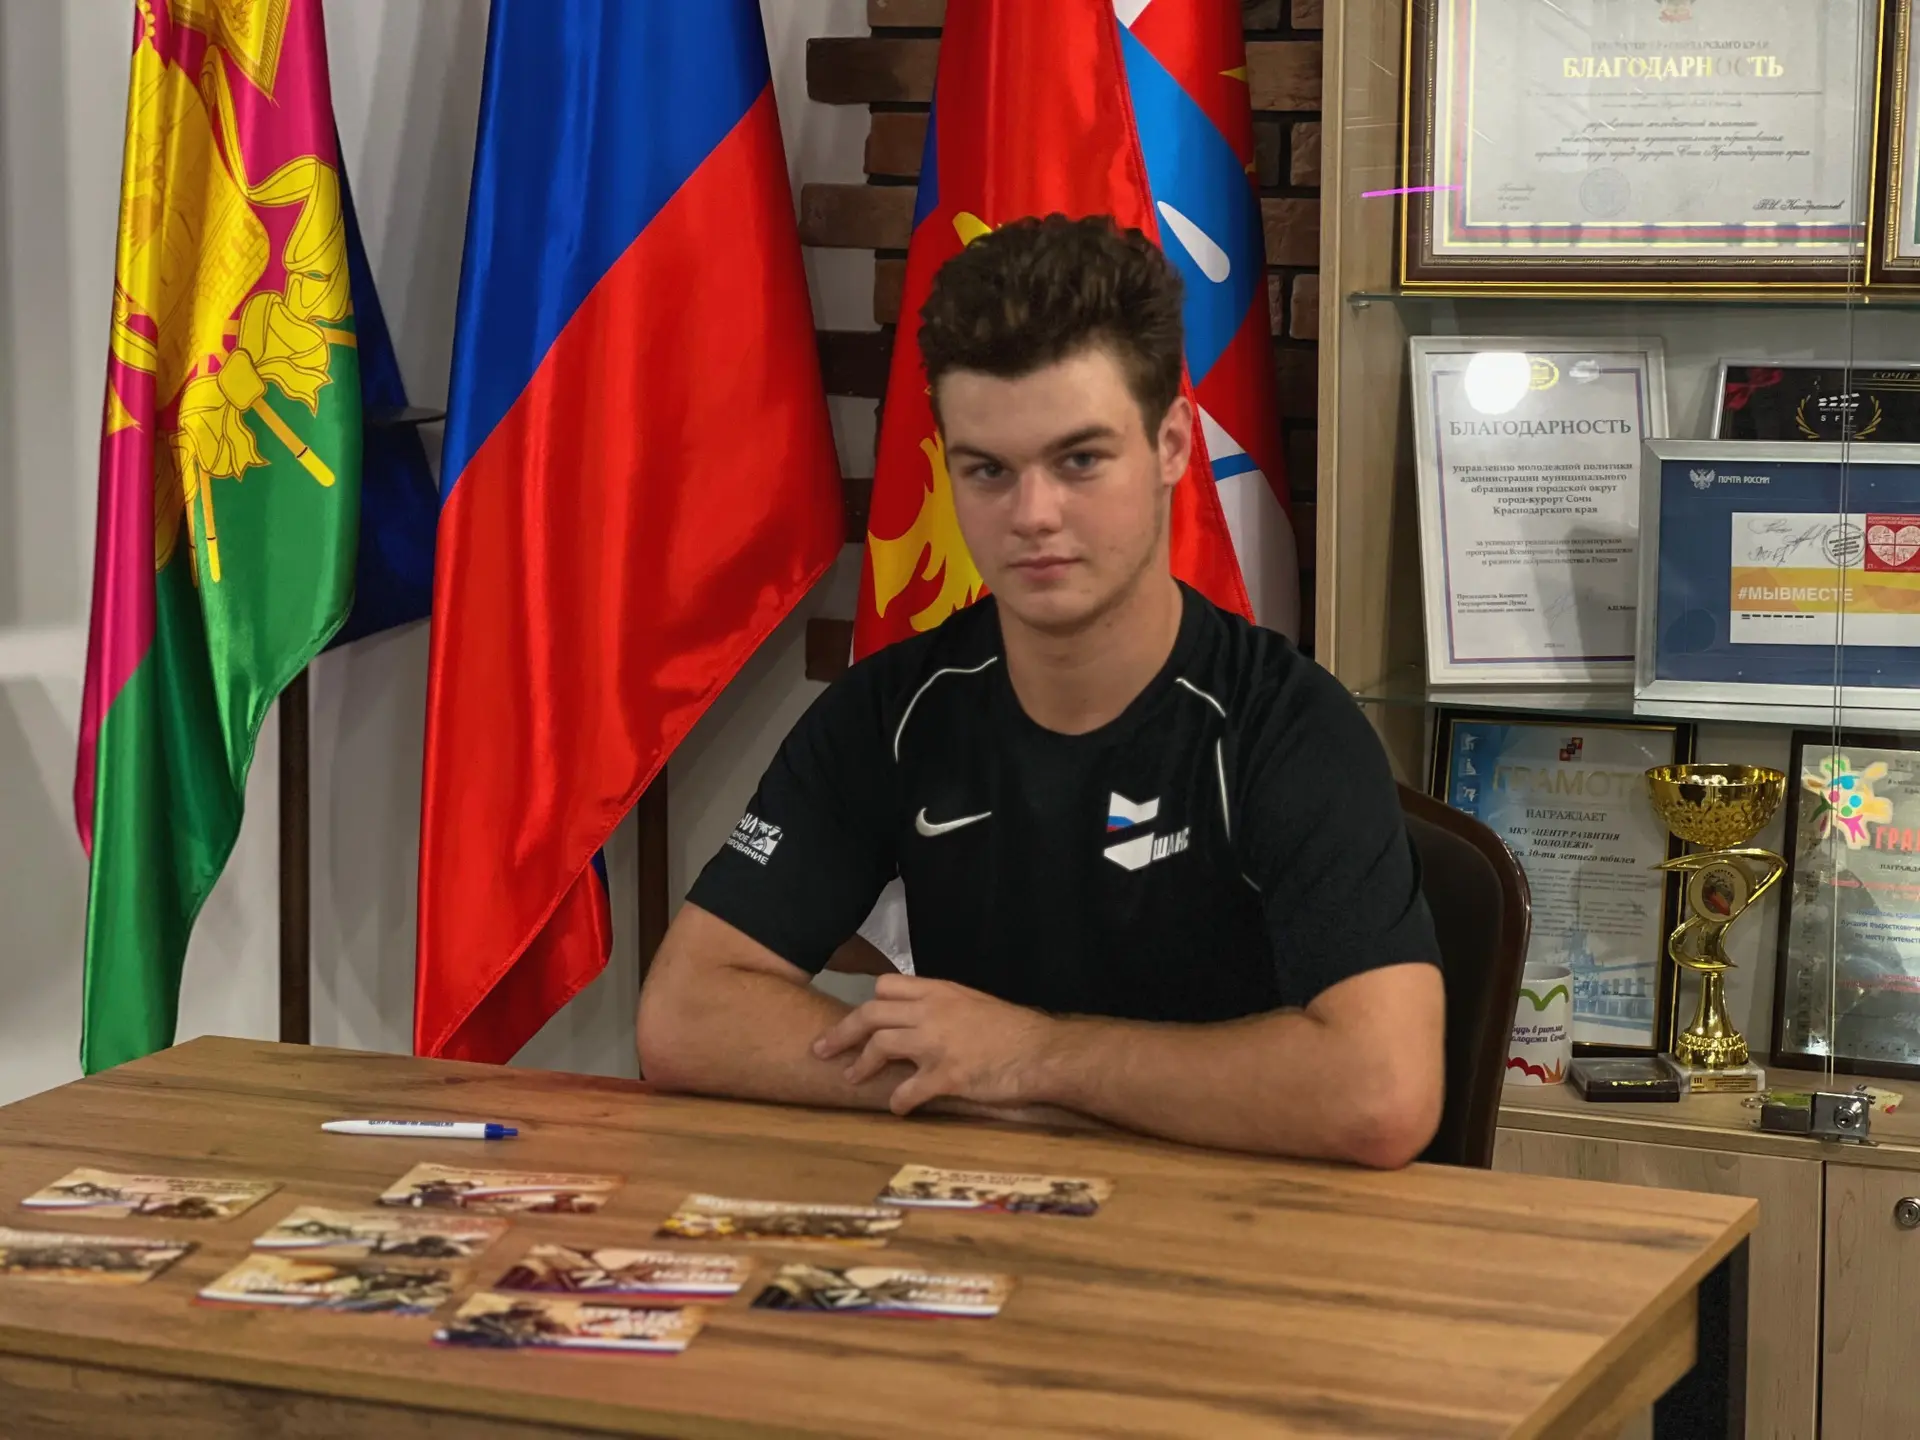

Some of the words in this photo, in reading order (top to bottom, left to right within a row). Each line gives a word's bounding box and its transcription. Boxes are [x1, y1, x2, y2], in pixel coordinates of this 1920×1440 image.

[1563, 56, 1784, 82] БЛАГОДАРНОСТЬ
[1449, 419, 1632, 438] БЛАГОДАРНОСТЬ
[1452, 464, 1515, 474] управлению
[1517, 462, 1581, 472] молодежной
[1583, 463, 1633, 471] политики
[1460, 474, 1539, 483] администрации
[1541, 474, 1627, 483] муниципального
[1718, 475, 1742, 484] ПОЧТА
[1743, 475, 1770, 484] РОССИИ
[1471, 484, 1533, 494] образования
[1535, 484, 1587, 494] городской
[1589, 484, 1617, 494] округ
[1497, 495, 1564, 506] город-курорт
[1565, 494, 1592, 503] Сочи
[1493, 506, 1573, 516] Краснодарского
[1574, 506, 1598, 515] края
[1737, 586, 1854, 602] #МЫВМЕСТЕ
[1526, 808, 1607, 823] НАГРАЖДАЕТ
[732, 830, 750, 844] НОЕ
[1508, 827, 1528, 836] МКУ
[1570, 831, 1620, 842] РАЗВИТИЯ
[1875, 825, 1920, 853] ГРА
[1532, 838, 1594, 850] МОЛОДЕЖИ»
[1528, 849, 1556, 860] 30-ти
[1557, 851, 1598, 862] летнего
[1600, 853, 1636, 865] юбилея
[1511, 1035, 1548, 1046] олодежи
